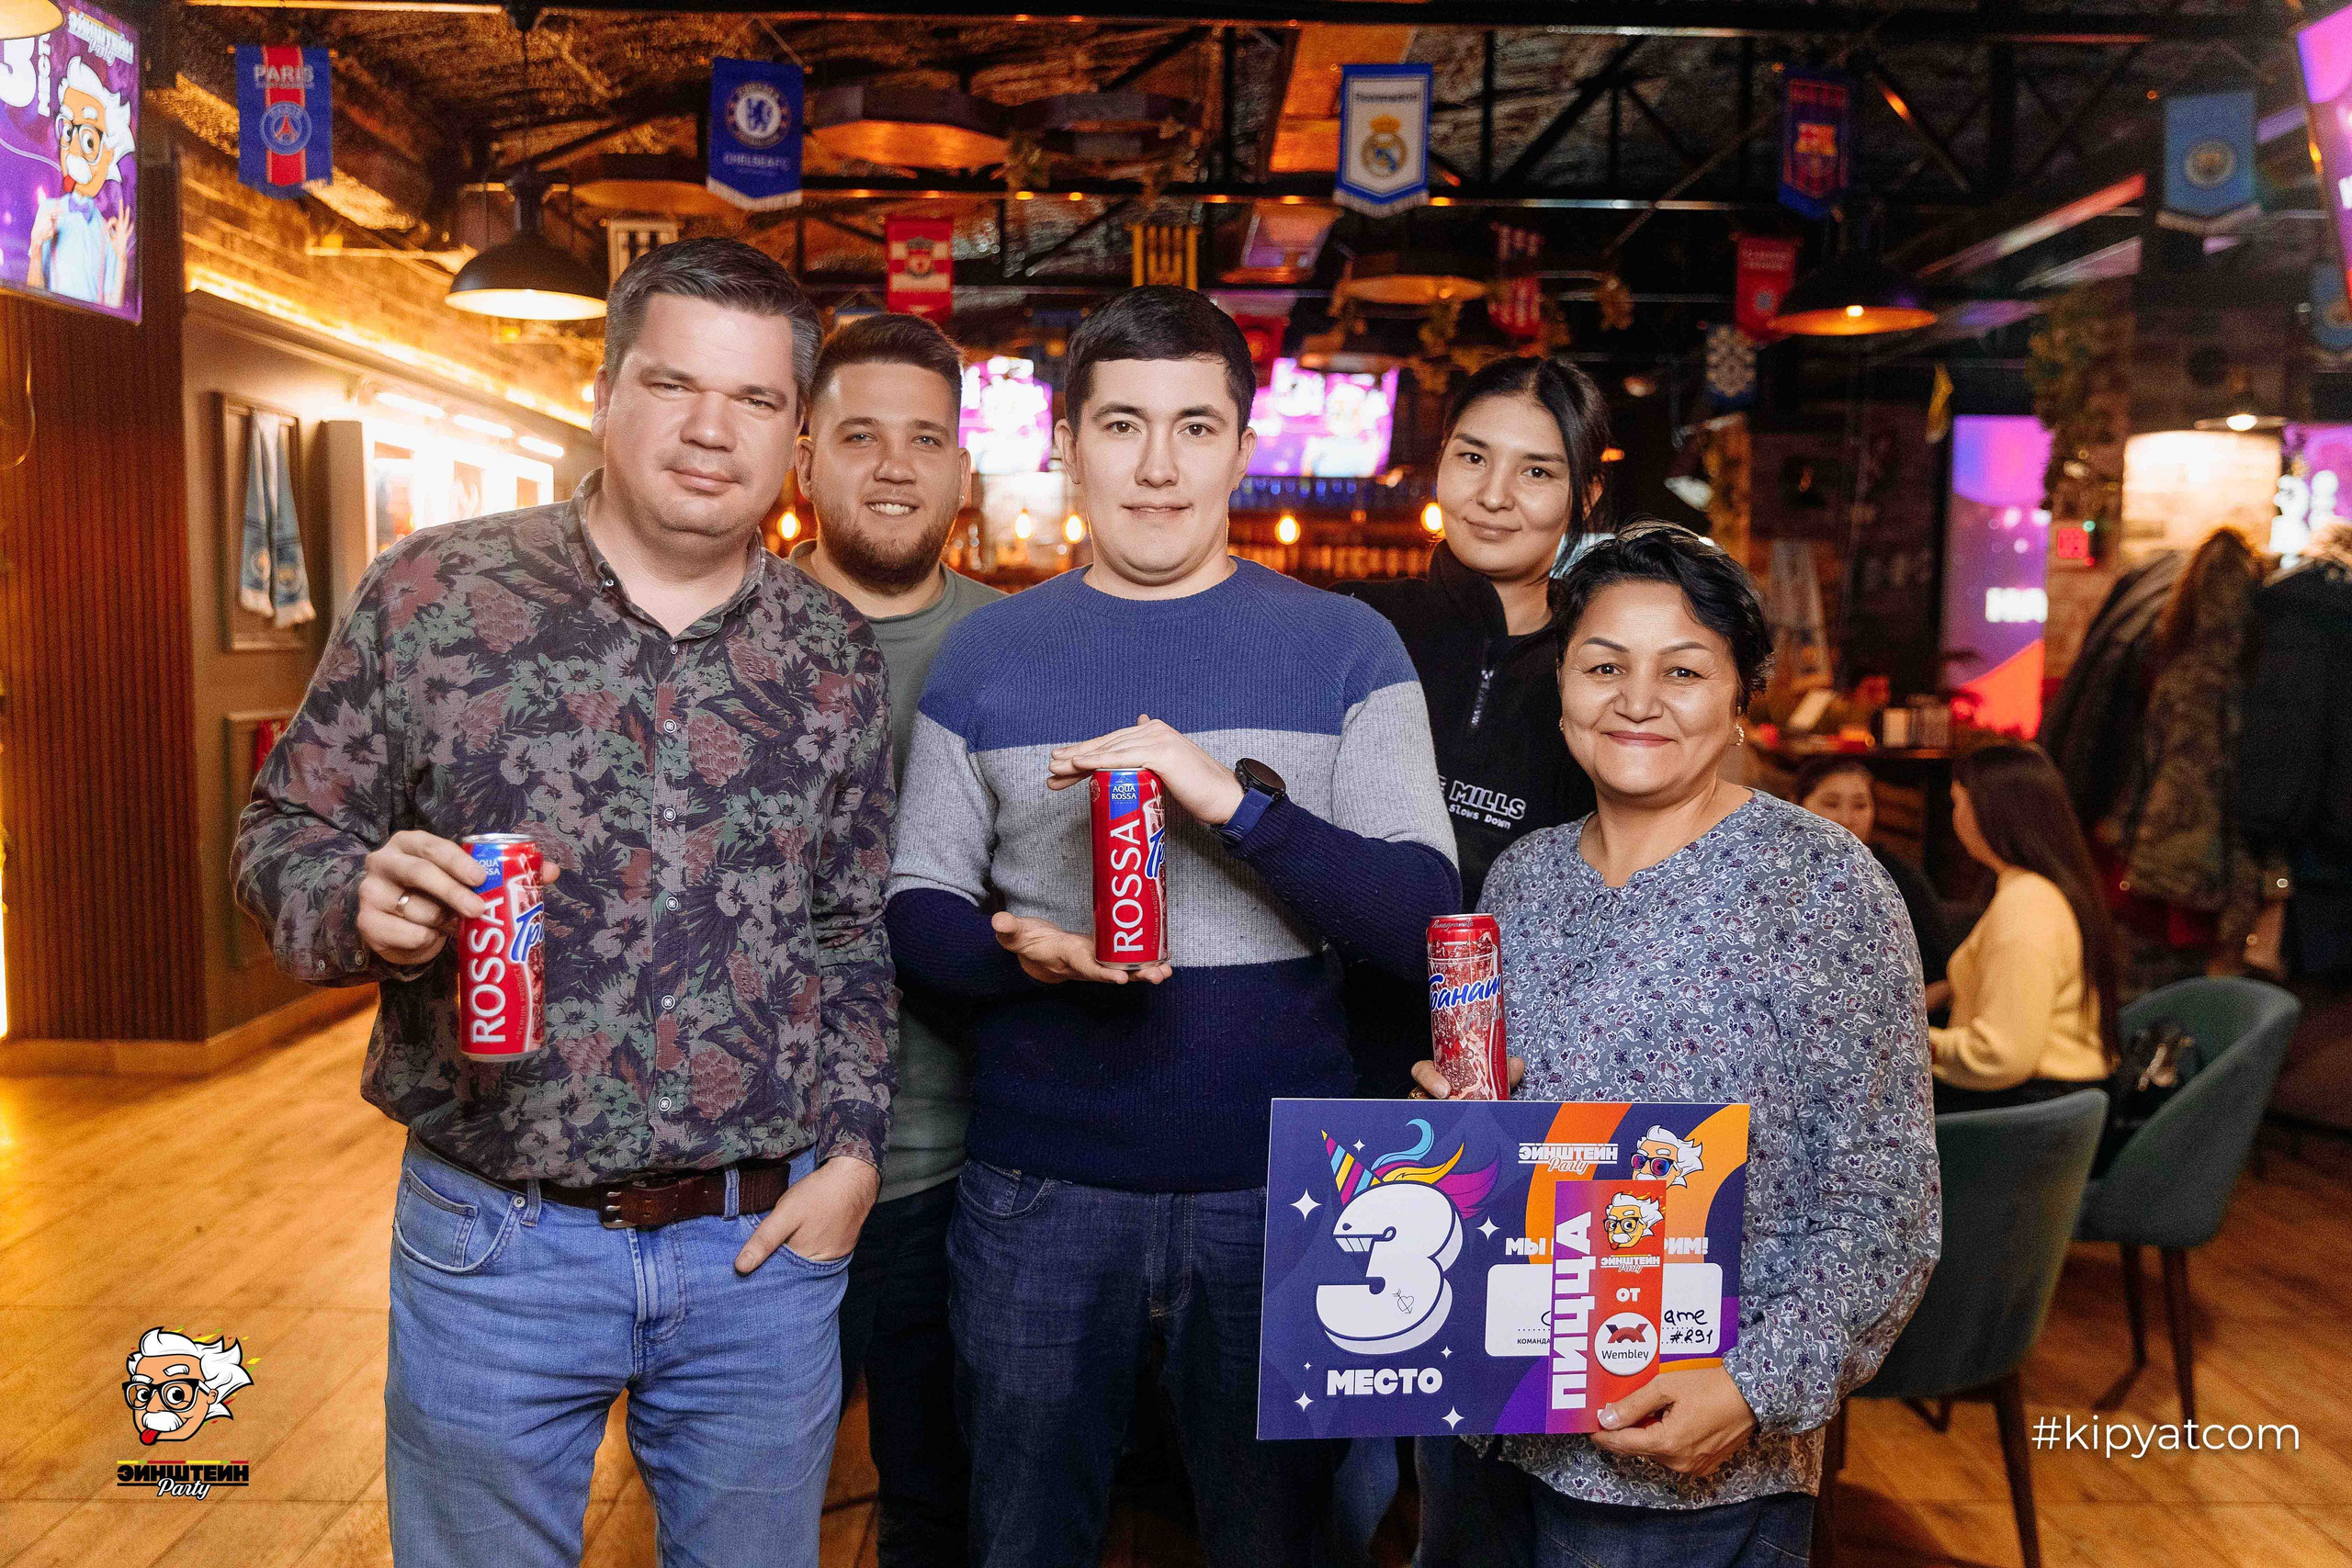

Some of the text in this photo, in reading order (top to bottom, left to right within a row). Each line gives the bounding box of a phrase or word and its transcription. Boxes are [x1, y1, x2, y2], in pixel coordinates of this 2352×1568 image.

[1449, 780, 1526, 819] MILLS
[1110, 818, 1144, 953] ROSSA
[472, 897, 506, 1043] ROSSA
[1547, 1157, 1589, 1175] Party
[1505, 1237, 1546, 1256] МЫ
[1316, 1182, 1464, 1355] 3
[1616, 1287, 1641, 1303] ОТ
[1552, 1211, 1597, 1410] ПИЦЦА
[1664, 1309, 1708, 1325] ame
[1601, 1348, 1649, 1360] Wembley
[1327, 1367, 1443, 1396] МЕСТО
